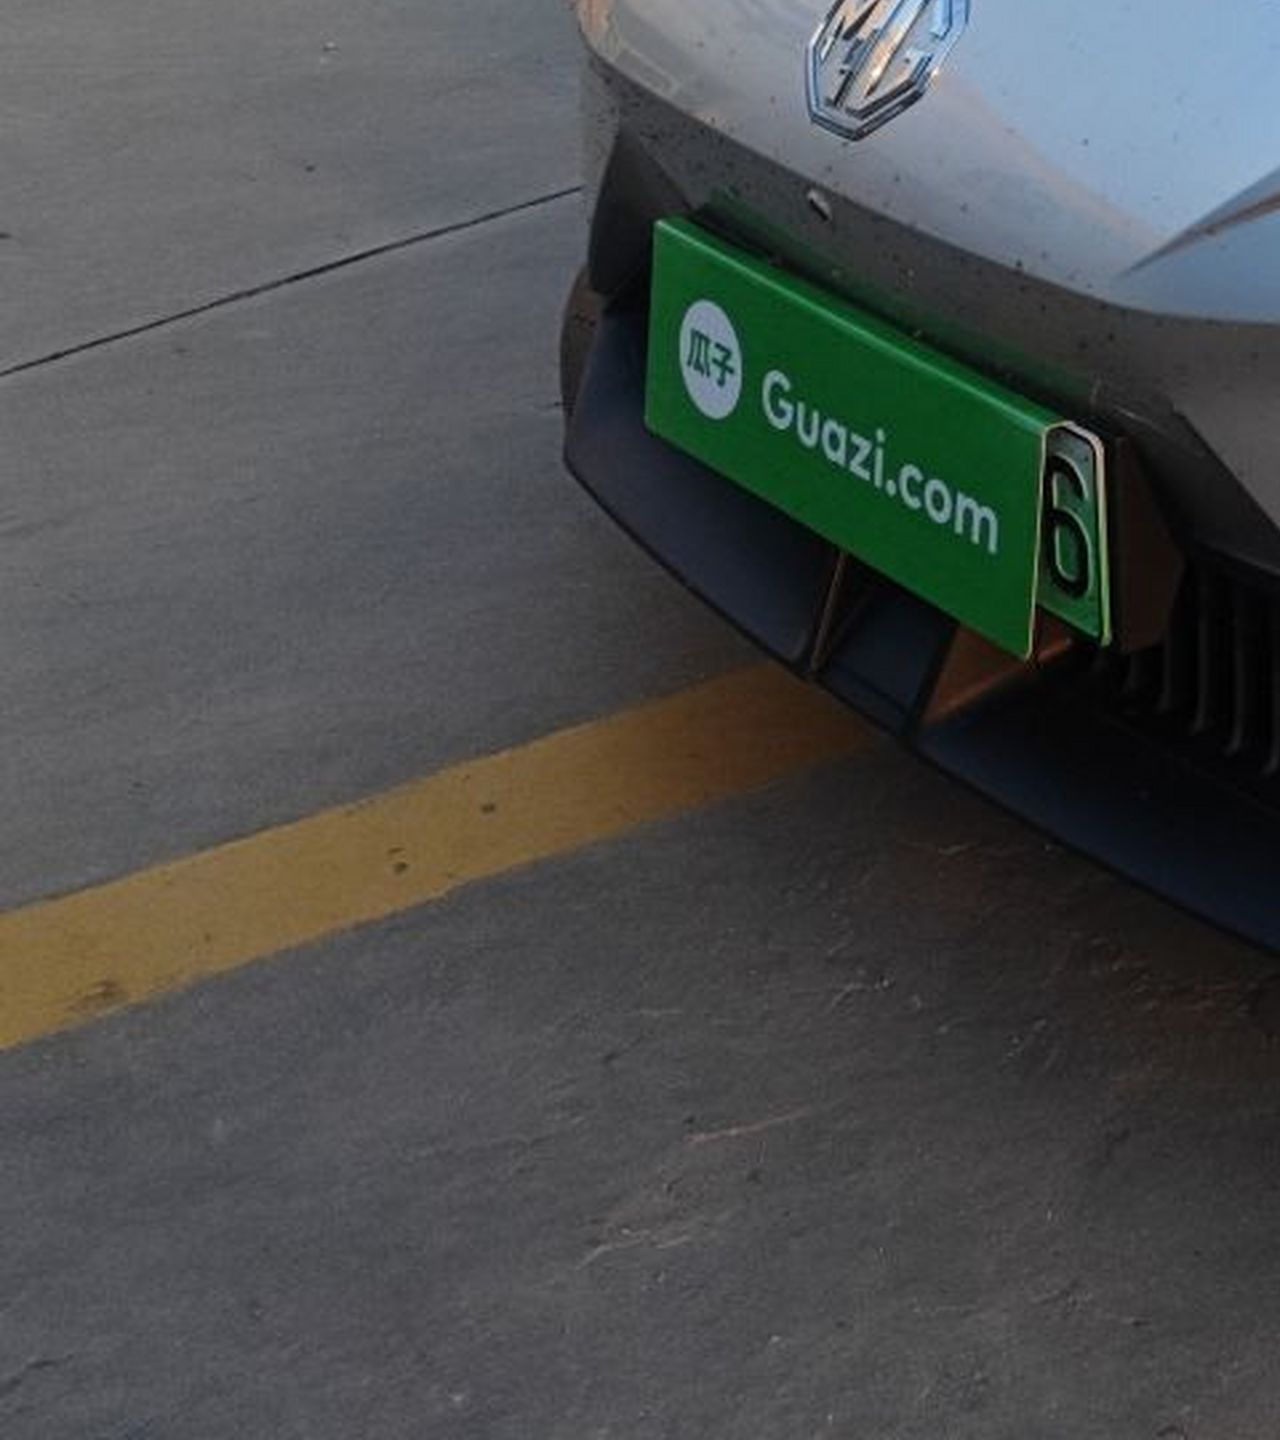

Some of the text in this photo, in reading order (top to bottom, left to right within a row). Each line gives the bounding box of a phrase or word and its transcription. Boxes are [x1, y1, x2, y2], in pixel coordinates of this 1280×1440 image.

[686, 328, 736, 388] 瓜子
[761, 369, 998, 554] Guazi.com
[1045, 453, 1095, 601] 6
